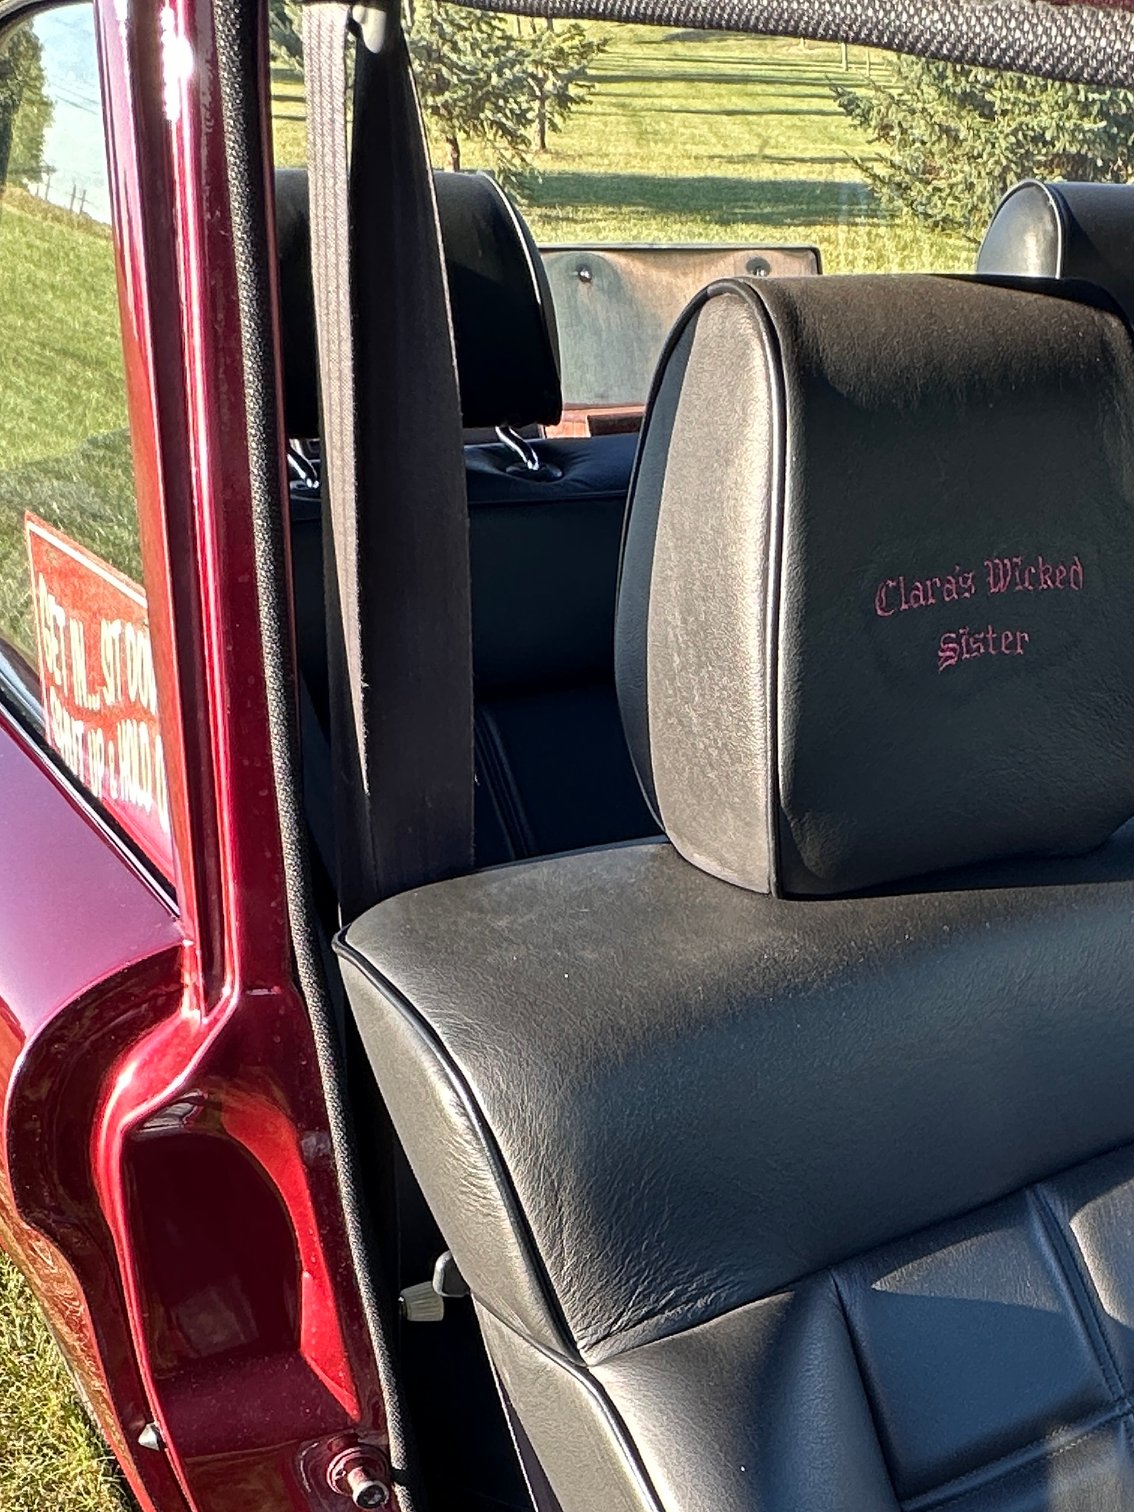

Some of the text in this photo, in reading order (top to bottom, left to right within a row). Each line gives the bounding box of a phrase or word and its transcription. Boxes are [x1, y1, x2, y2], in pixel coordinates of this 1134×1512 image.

[874, 555, 1084, 617] Clara's Wicked
[937, 625, 1029, 674] Sister
[155, 734, 172, 833] O
